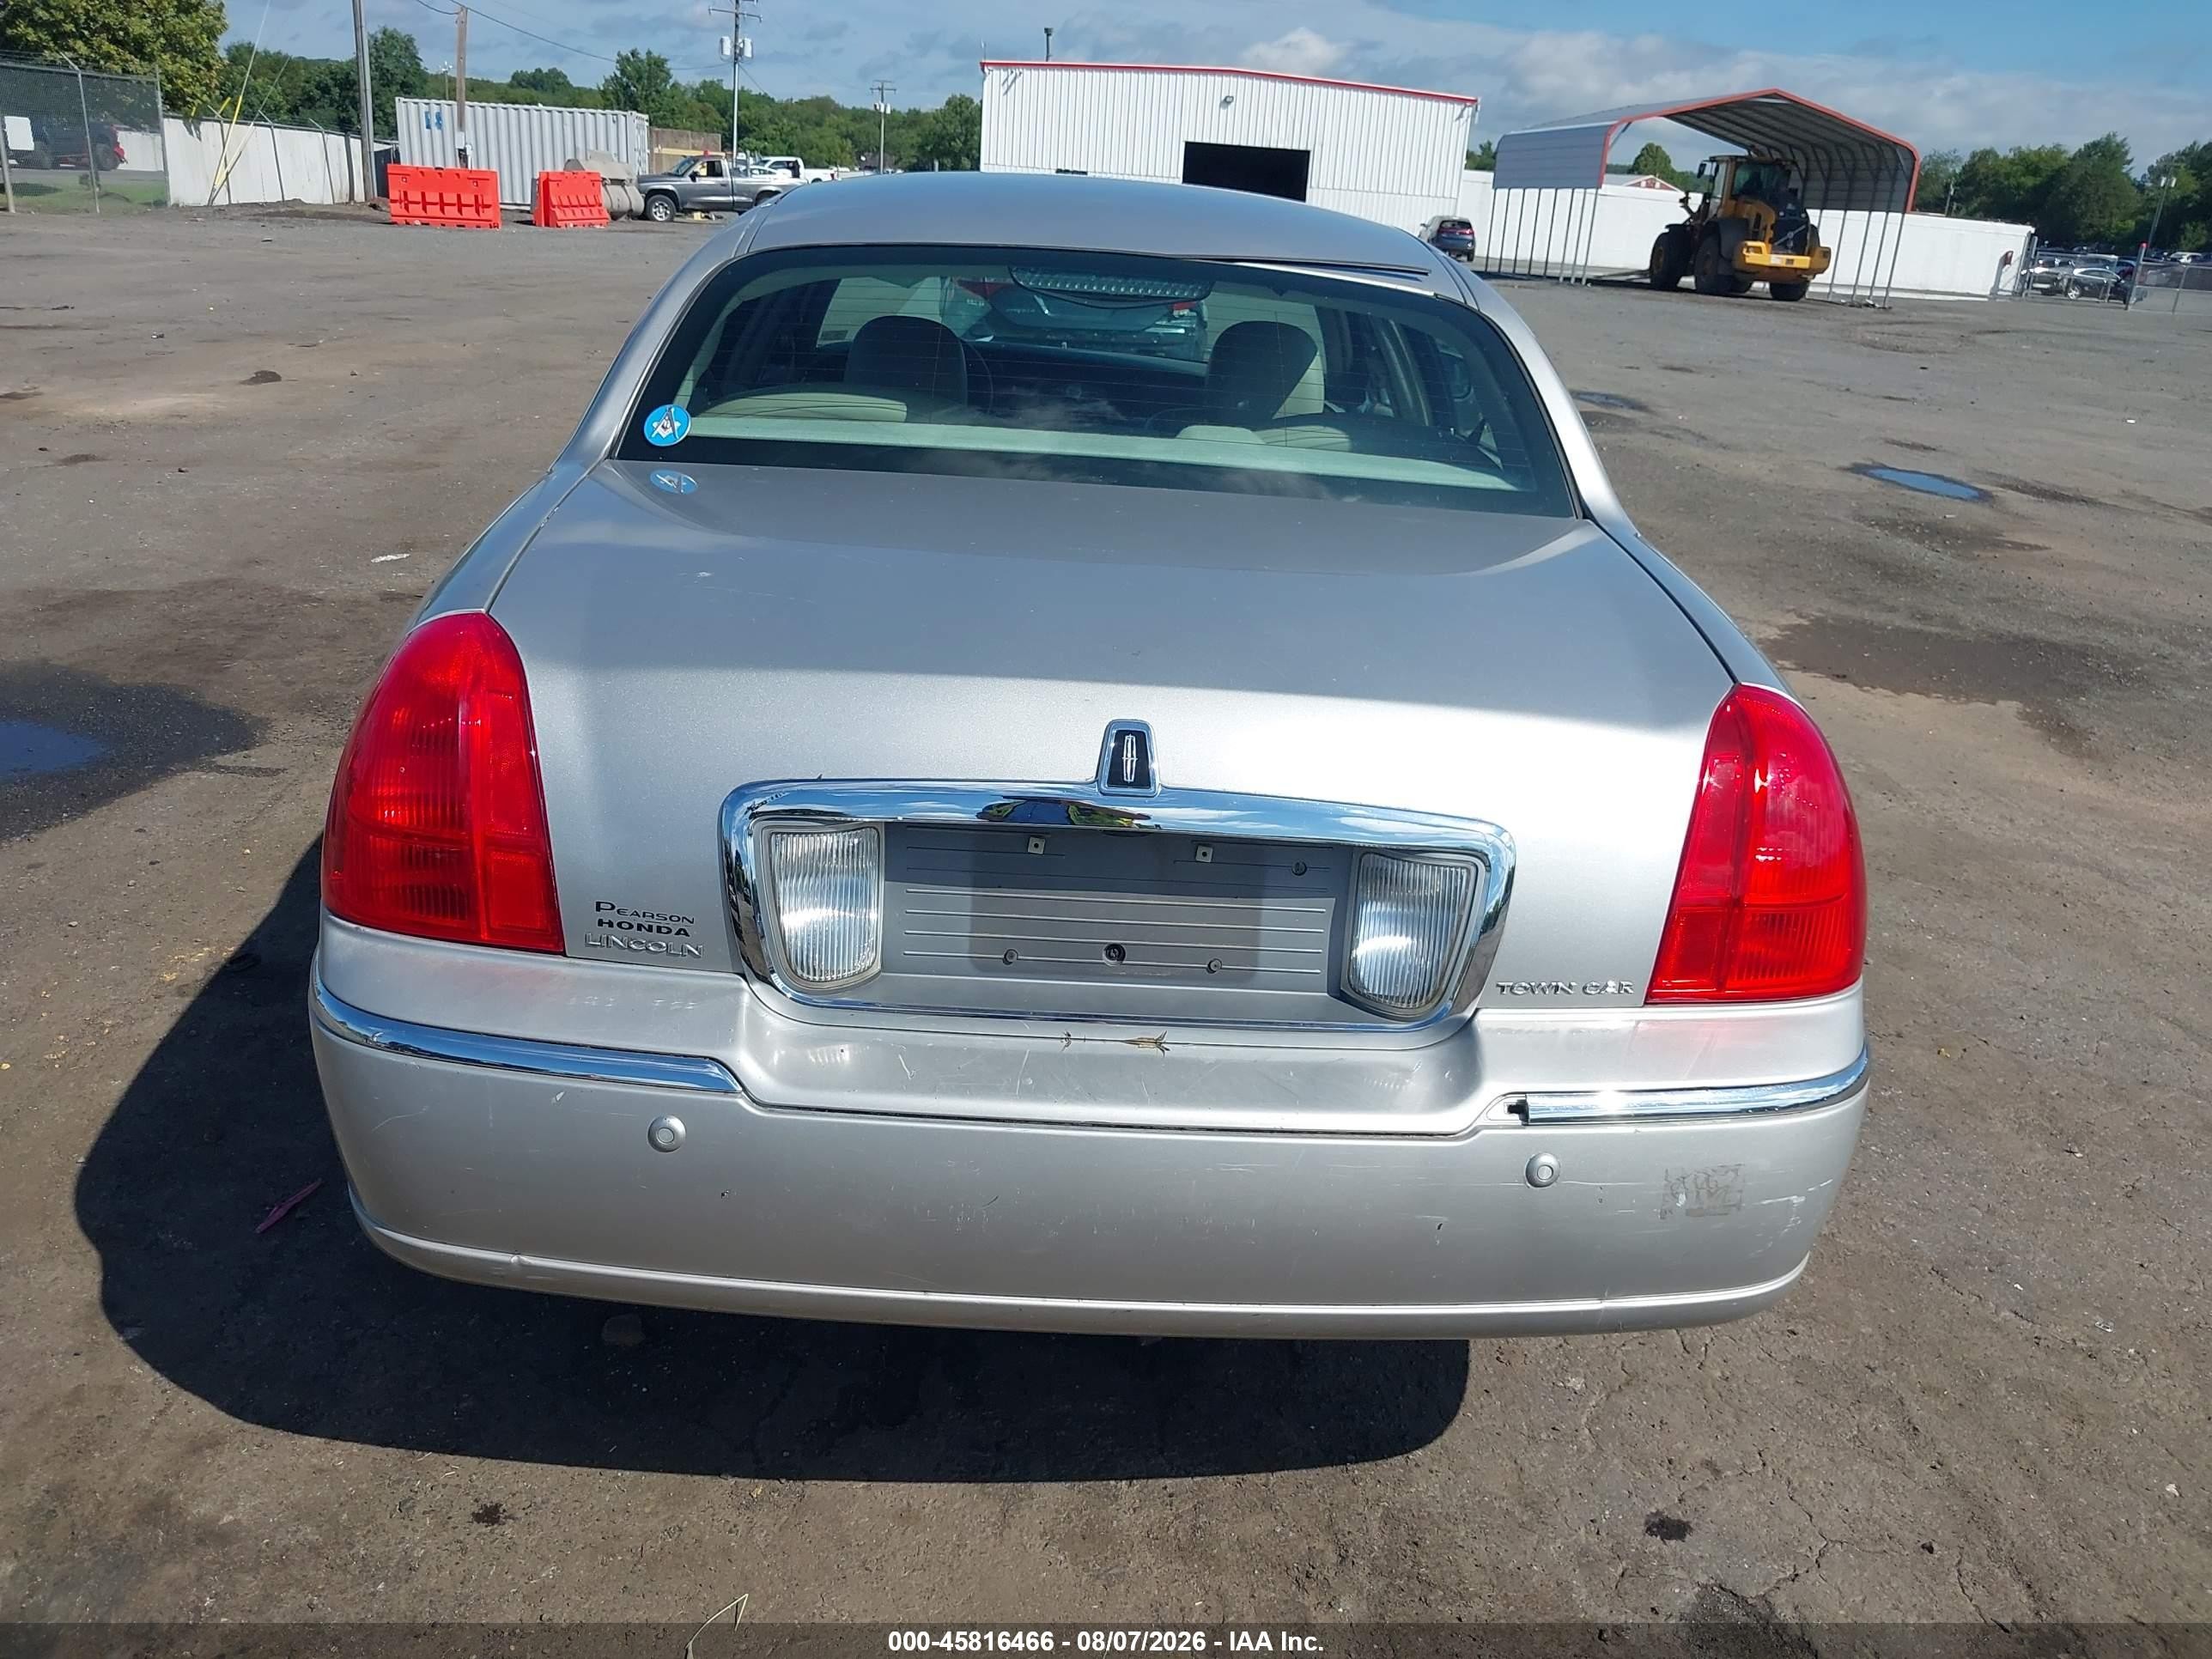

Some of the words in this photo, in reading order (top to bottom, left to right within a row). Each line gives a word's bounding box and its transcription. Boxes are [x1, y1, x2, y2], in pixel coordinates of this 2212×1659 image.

[595, 901, 695, 924] PEARSON
[597, 918, 690, 937] HONDA
[585, 933, 703, 957] LINCOLN
[1497, 981, 1577, 995] TOWN
[1583, 980, 1634, 995] CAR
